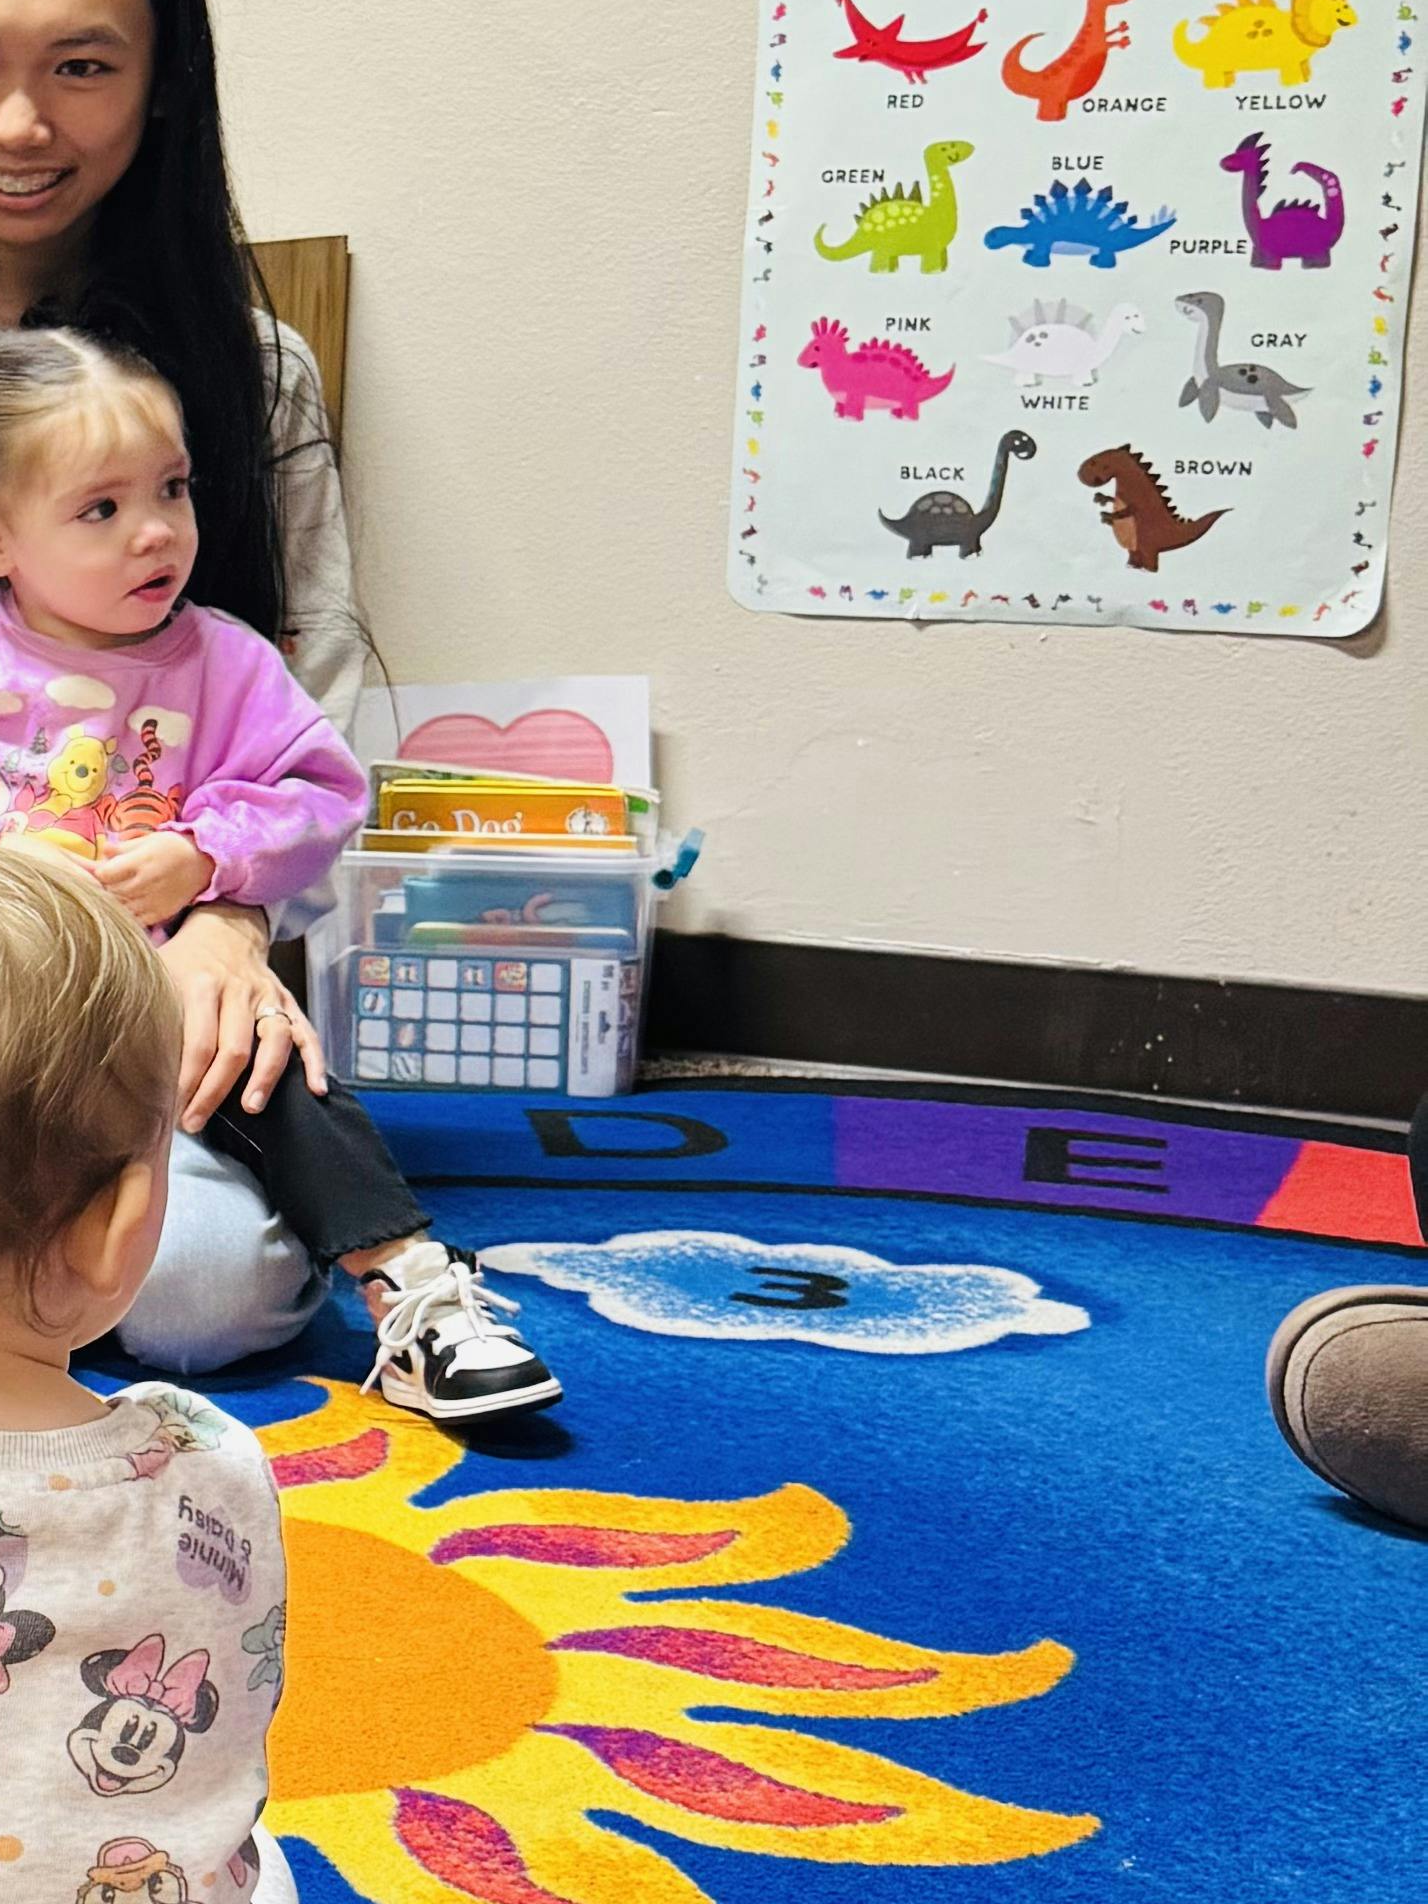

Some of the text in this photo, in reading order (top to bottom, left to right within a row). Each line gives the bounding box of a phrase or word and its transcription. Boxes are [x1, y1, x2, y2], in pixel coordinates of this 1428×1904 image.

[887, 94, 924, 109] RED
[1083, 96, 1167, 114] ORANGE
[1236, 94, 1327, 112] YELLOW
[1051, 155, 1104, 172] BLUE
[822, 168, 885, 184] GREEN
[1170, 238, 1248, 256] PURPLE
[885, 317, 931, 333] PINK
[1251, 332, 1307, 349] GRAY
[1021, 395, 1090, 412] WHITE
[900, 465, 965, 482] BLACK
[1174, 459, 1253, 477] BROWN
[523, 1107, 728, 1159] D
[1022, 1126, 1169, 1194] E
[732, 1265, 850, 1311] 3
[178, 1495, 235, 1553] Daisy
[178, 1533, 245, 1591] Minnie
